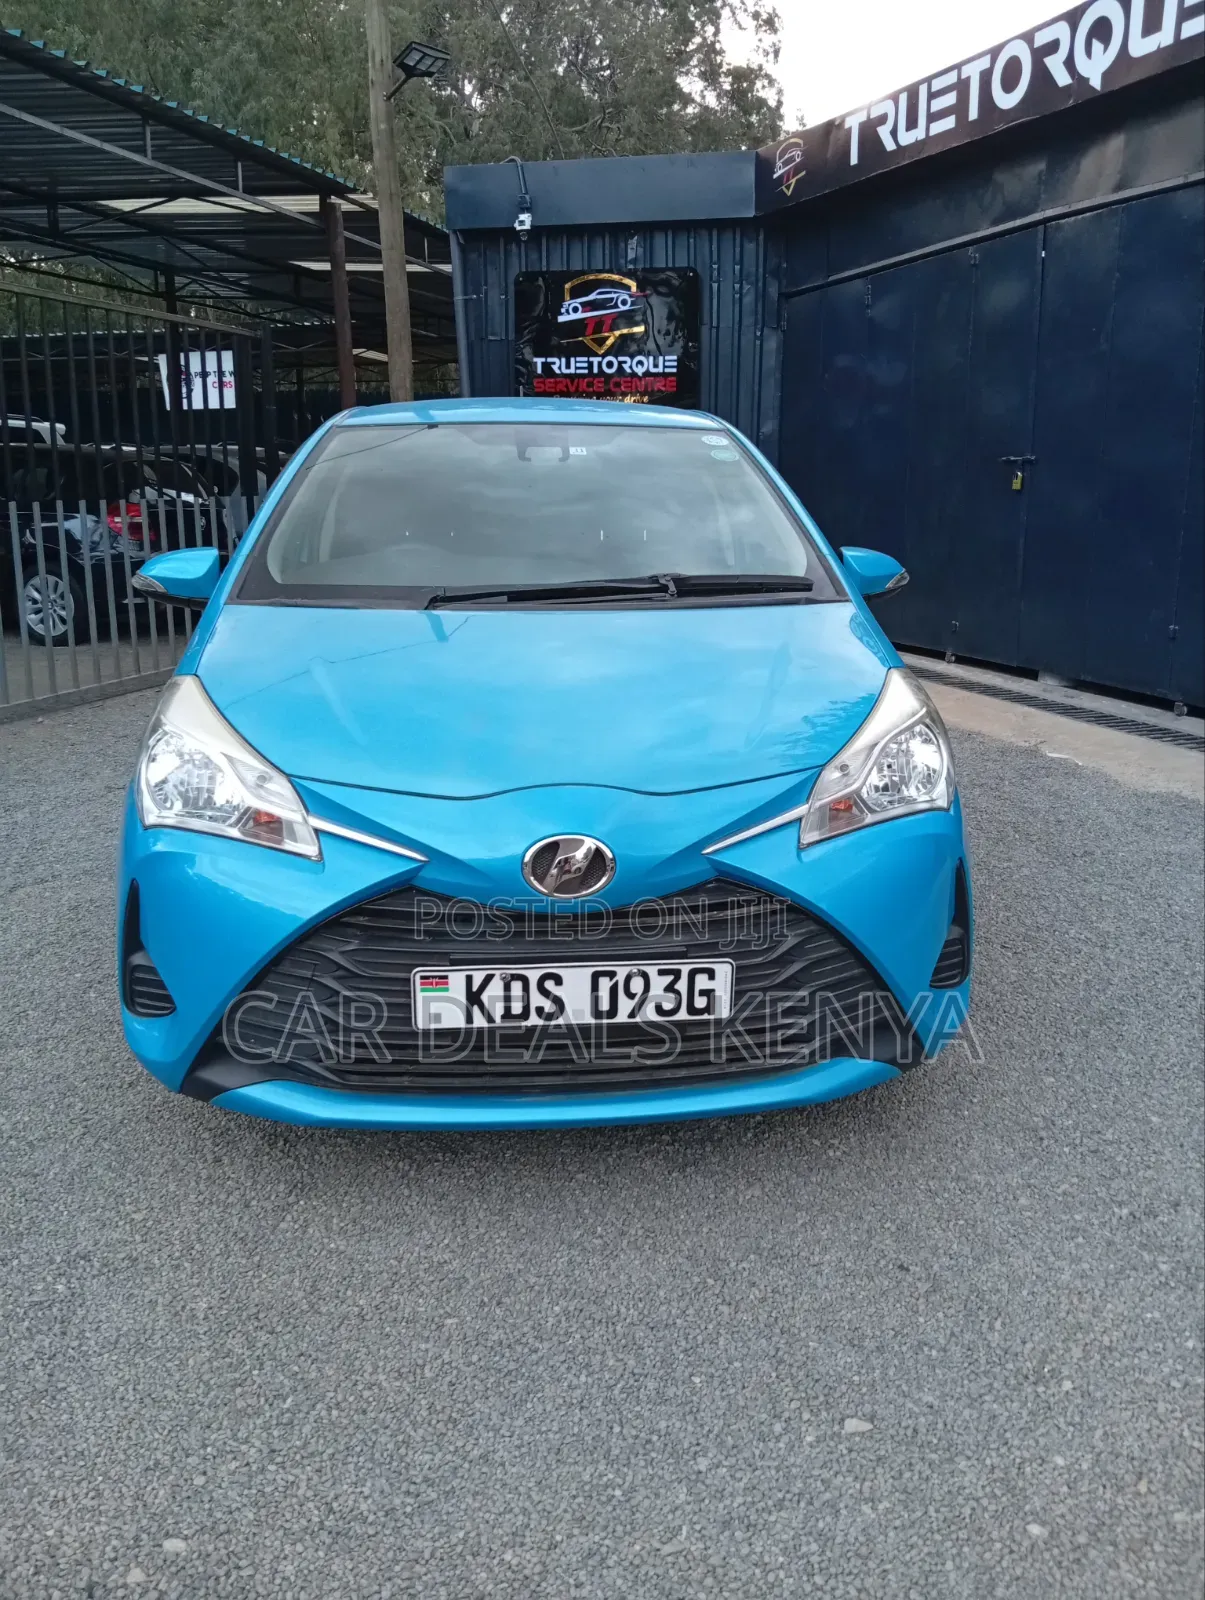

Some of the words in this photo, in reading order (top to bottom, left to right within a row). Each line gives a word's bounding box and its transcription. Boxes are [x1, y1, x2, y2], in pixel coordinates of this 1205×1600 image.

[533, 355, 677, 376] TRUETORQUE
[213, 370, 228, 378] TE
[212, 381, 233, 389] CRS
[533, 378, 605, 392] SERVICE
[610, 376, 677, 392] CENTRE
[465, 972, 566, 1025] KDS
[590, 967, 715, 1020] 093G
